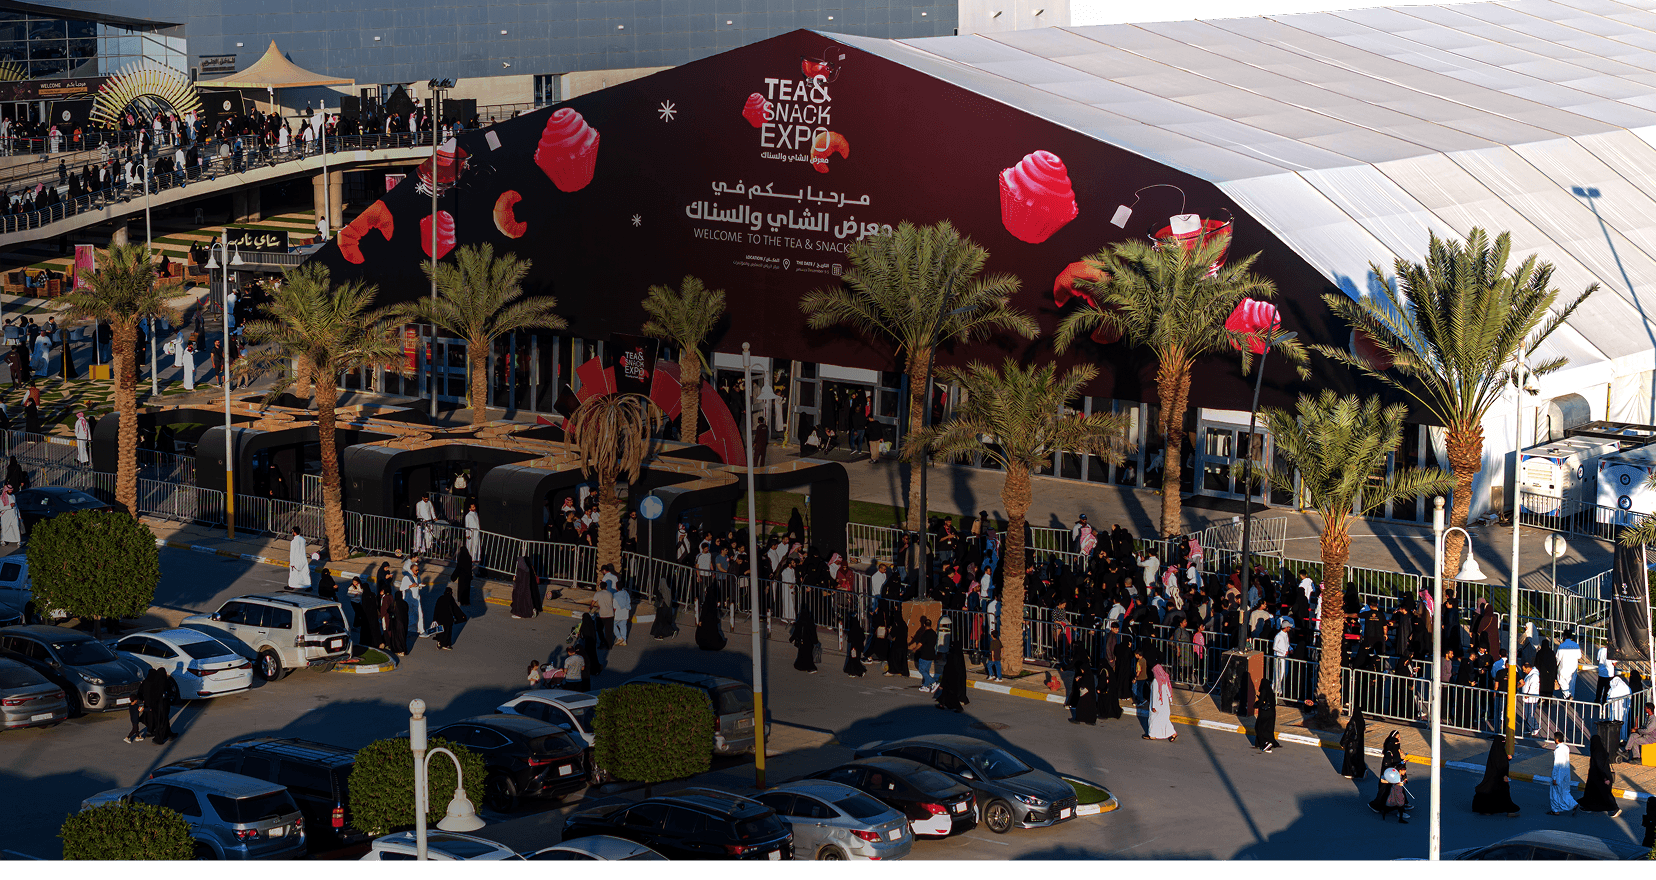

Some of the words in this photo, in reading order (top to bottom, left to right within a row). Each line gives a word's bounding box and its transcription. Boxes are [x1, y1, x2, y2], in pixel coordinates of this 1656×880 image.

[762, 101, 832, 125] SNACK
[760, 122, 831, 152] EXPO
[760, 152, 787, 162] والسناك
[787, 154, 809, 163] الشاي
[809, 156, 829, 165] معرض
[711, 179, 745, 196] في
[748, 182, 803, 204] بكم
[806, 185, 871, 208] مرحبا
[685, 200, 763, 231] والسناك
[766, 207, 830, 233] الشاي
[253, 233, 281, 250] شاي
[693, 227, 743, 243] WELCOME
[747, 233, 761, 245] TO
[762, 235, 782, 247] THE
[784, 237, 803, 249] TEA
[804, 238, 813, 250] &
[815, 240, 850, 253] SNACK
[624, 359, 645, 368] SNACK
[624, 365, 645, 376] EXPO
